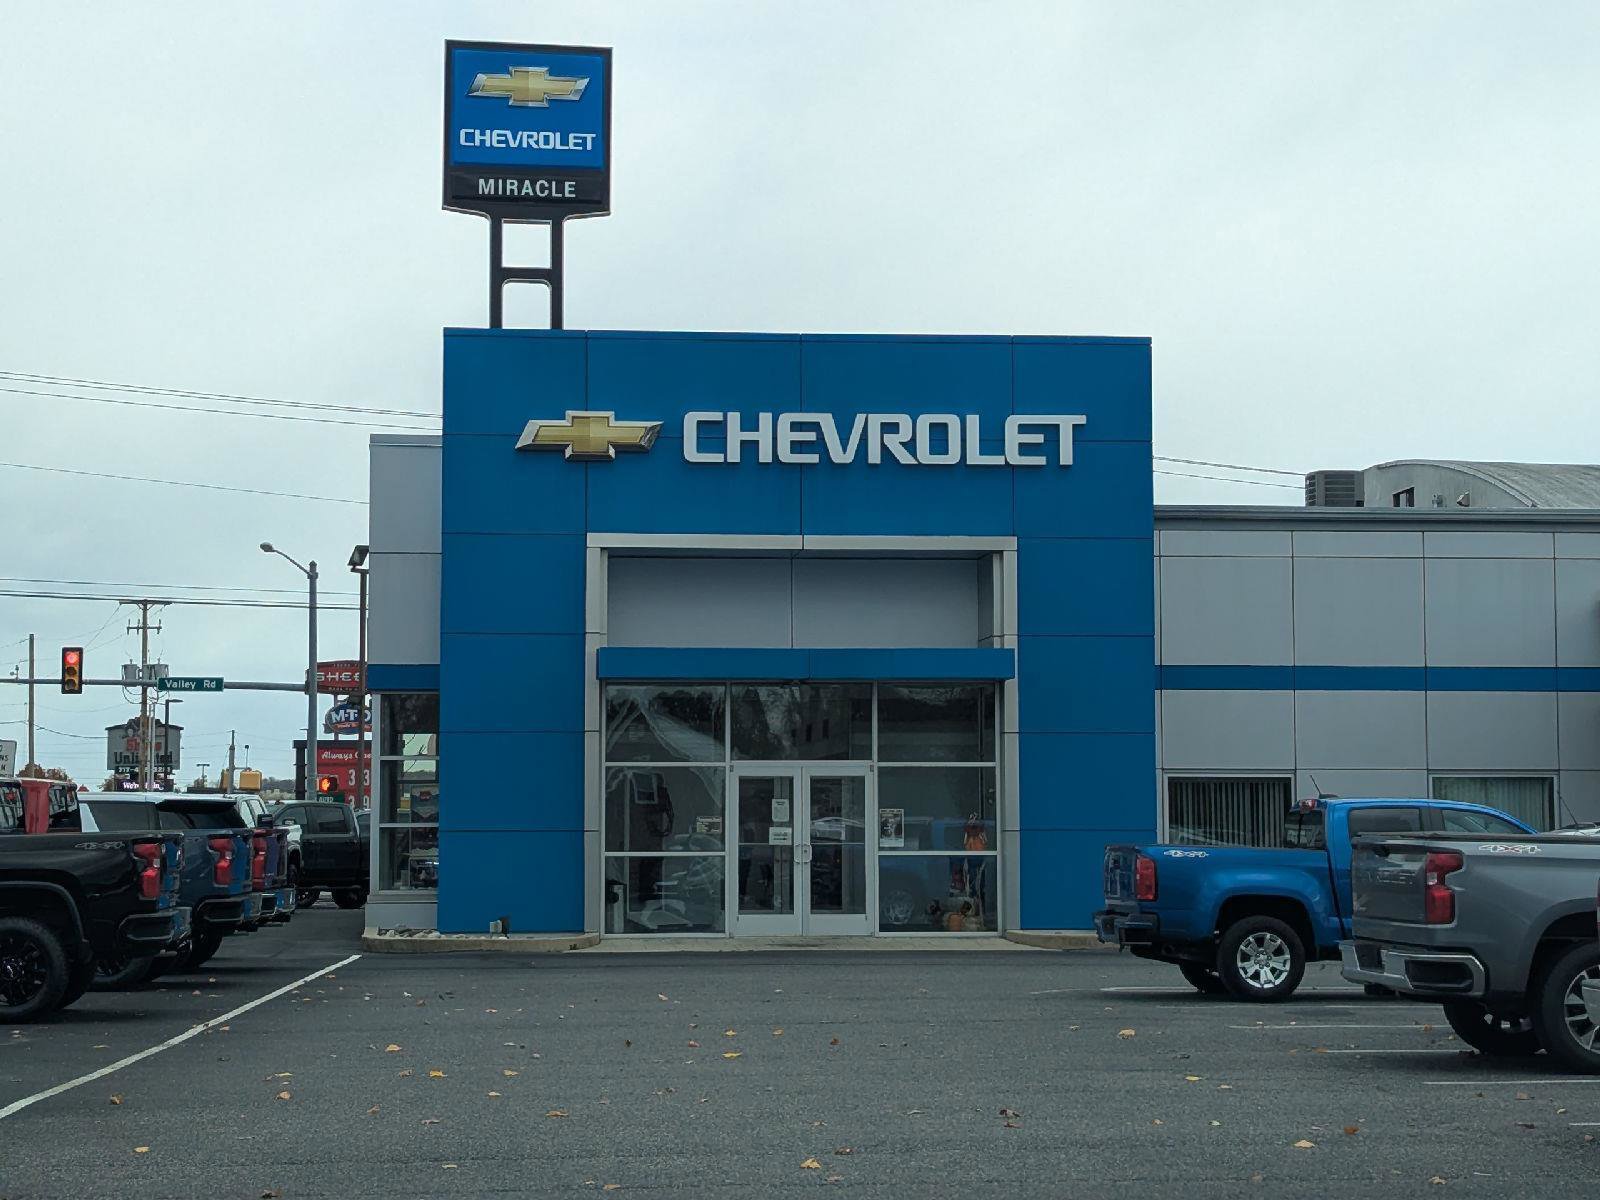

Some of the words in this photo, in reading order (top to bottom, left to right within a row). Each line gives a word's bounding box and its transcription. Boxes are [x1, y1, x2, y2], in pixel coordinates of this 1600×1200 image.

[459, 128, 596, 151] CHEVROLET
[478, 178, 577, 198] MIRACLE
[682, 411, 1087, 467] CHEVROLET
[165, 679, 197, 690] Valley
[203, 679, 217, 689] Rd
